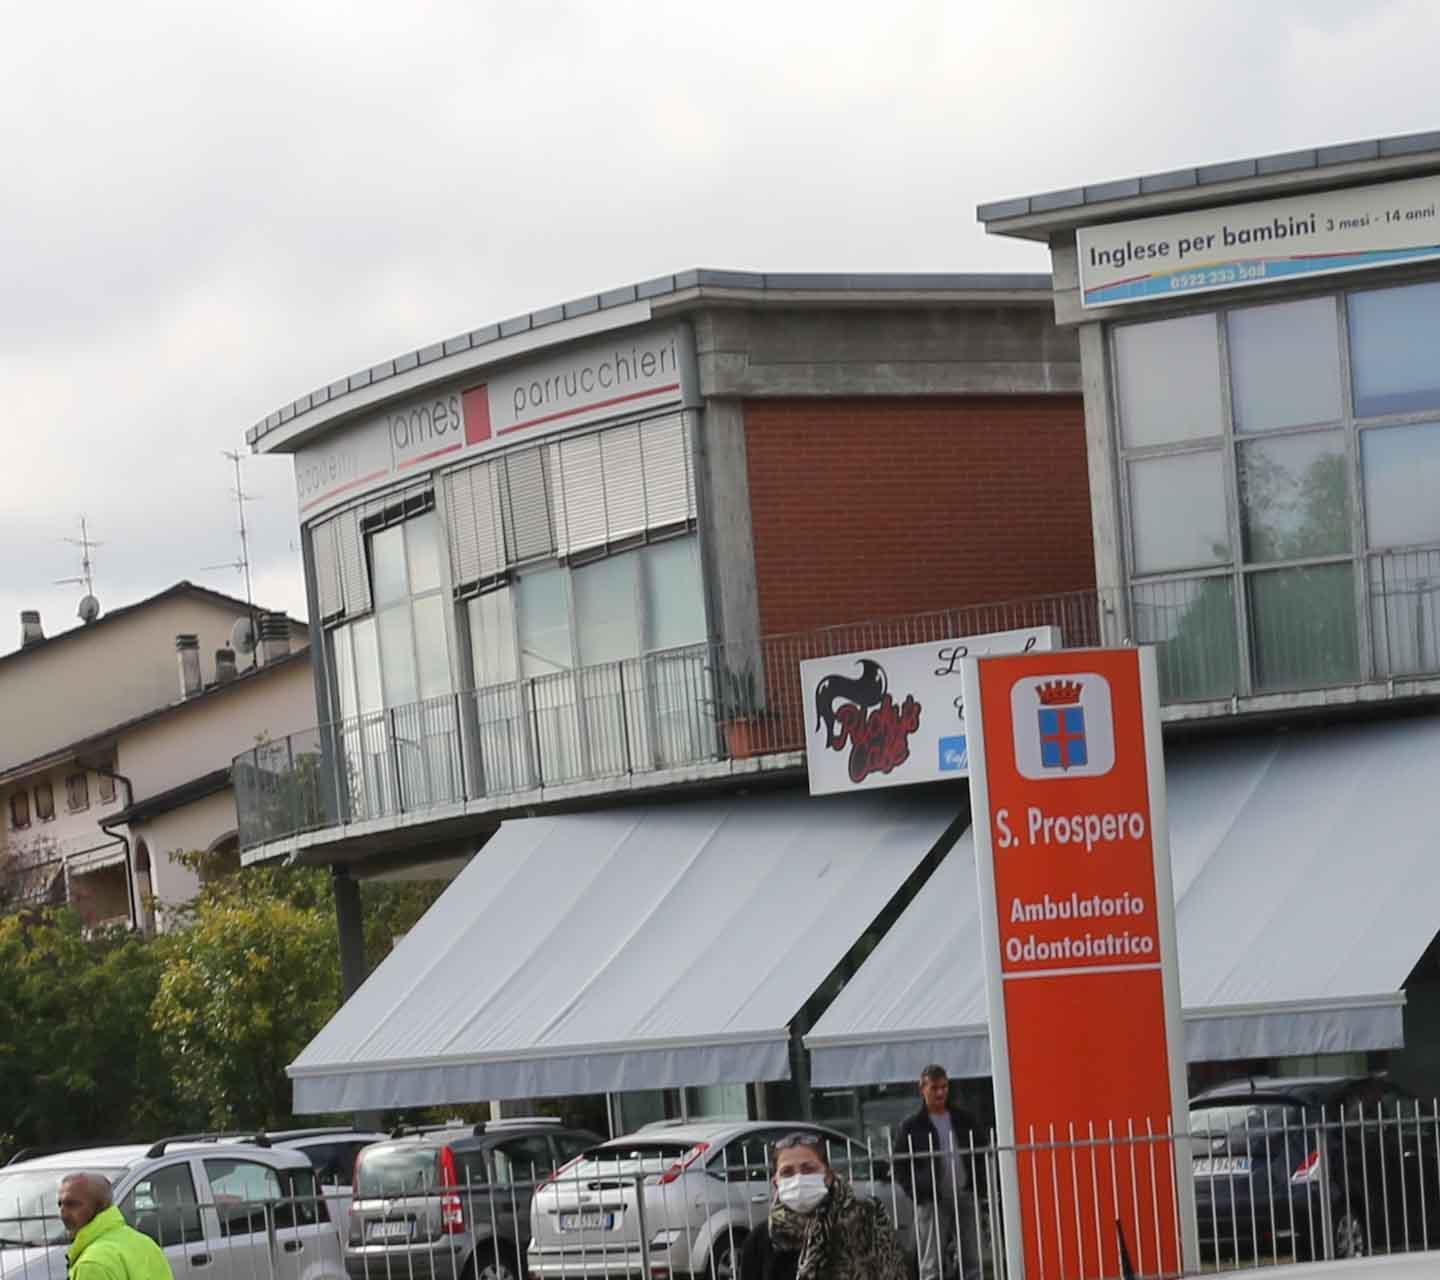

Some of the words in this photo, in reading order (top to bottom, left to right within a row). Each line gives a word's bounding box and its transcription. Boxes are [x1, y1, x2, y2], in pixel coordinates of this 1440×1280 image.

[1090, 240, 1170, 268] Inglese
[1178, 233, 1216, 259] per
[1223, 213, 1316, 246] bambini
[1325, 219, 1335, 232] 3
[1339, 213, 1370, 229] mesi
[1385, 209, 1401, 224] 14
[1405, 203, 1436, 221] anni
[512, 337, 680, 420] parrucchieri
[386, 395, 461, 474] james
[995, 808, 1020, 849] S.
[1027, 806, 1145, 853] Prospero
[1010, 891, 1145, 923] Ambulatorio
[1006, 931, 1153, 962] Odontoiatrico
